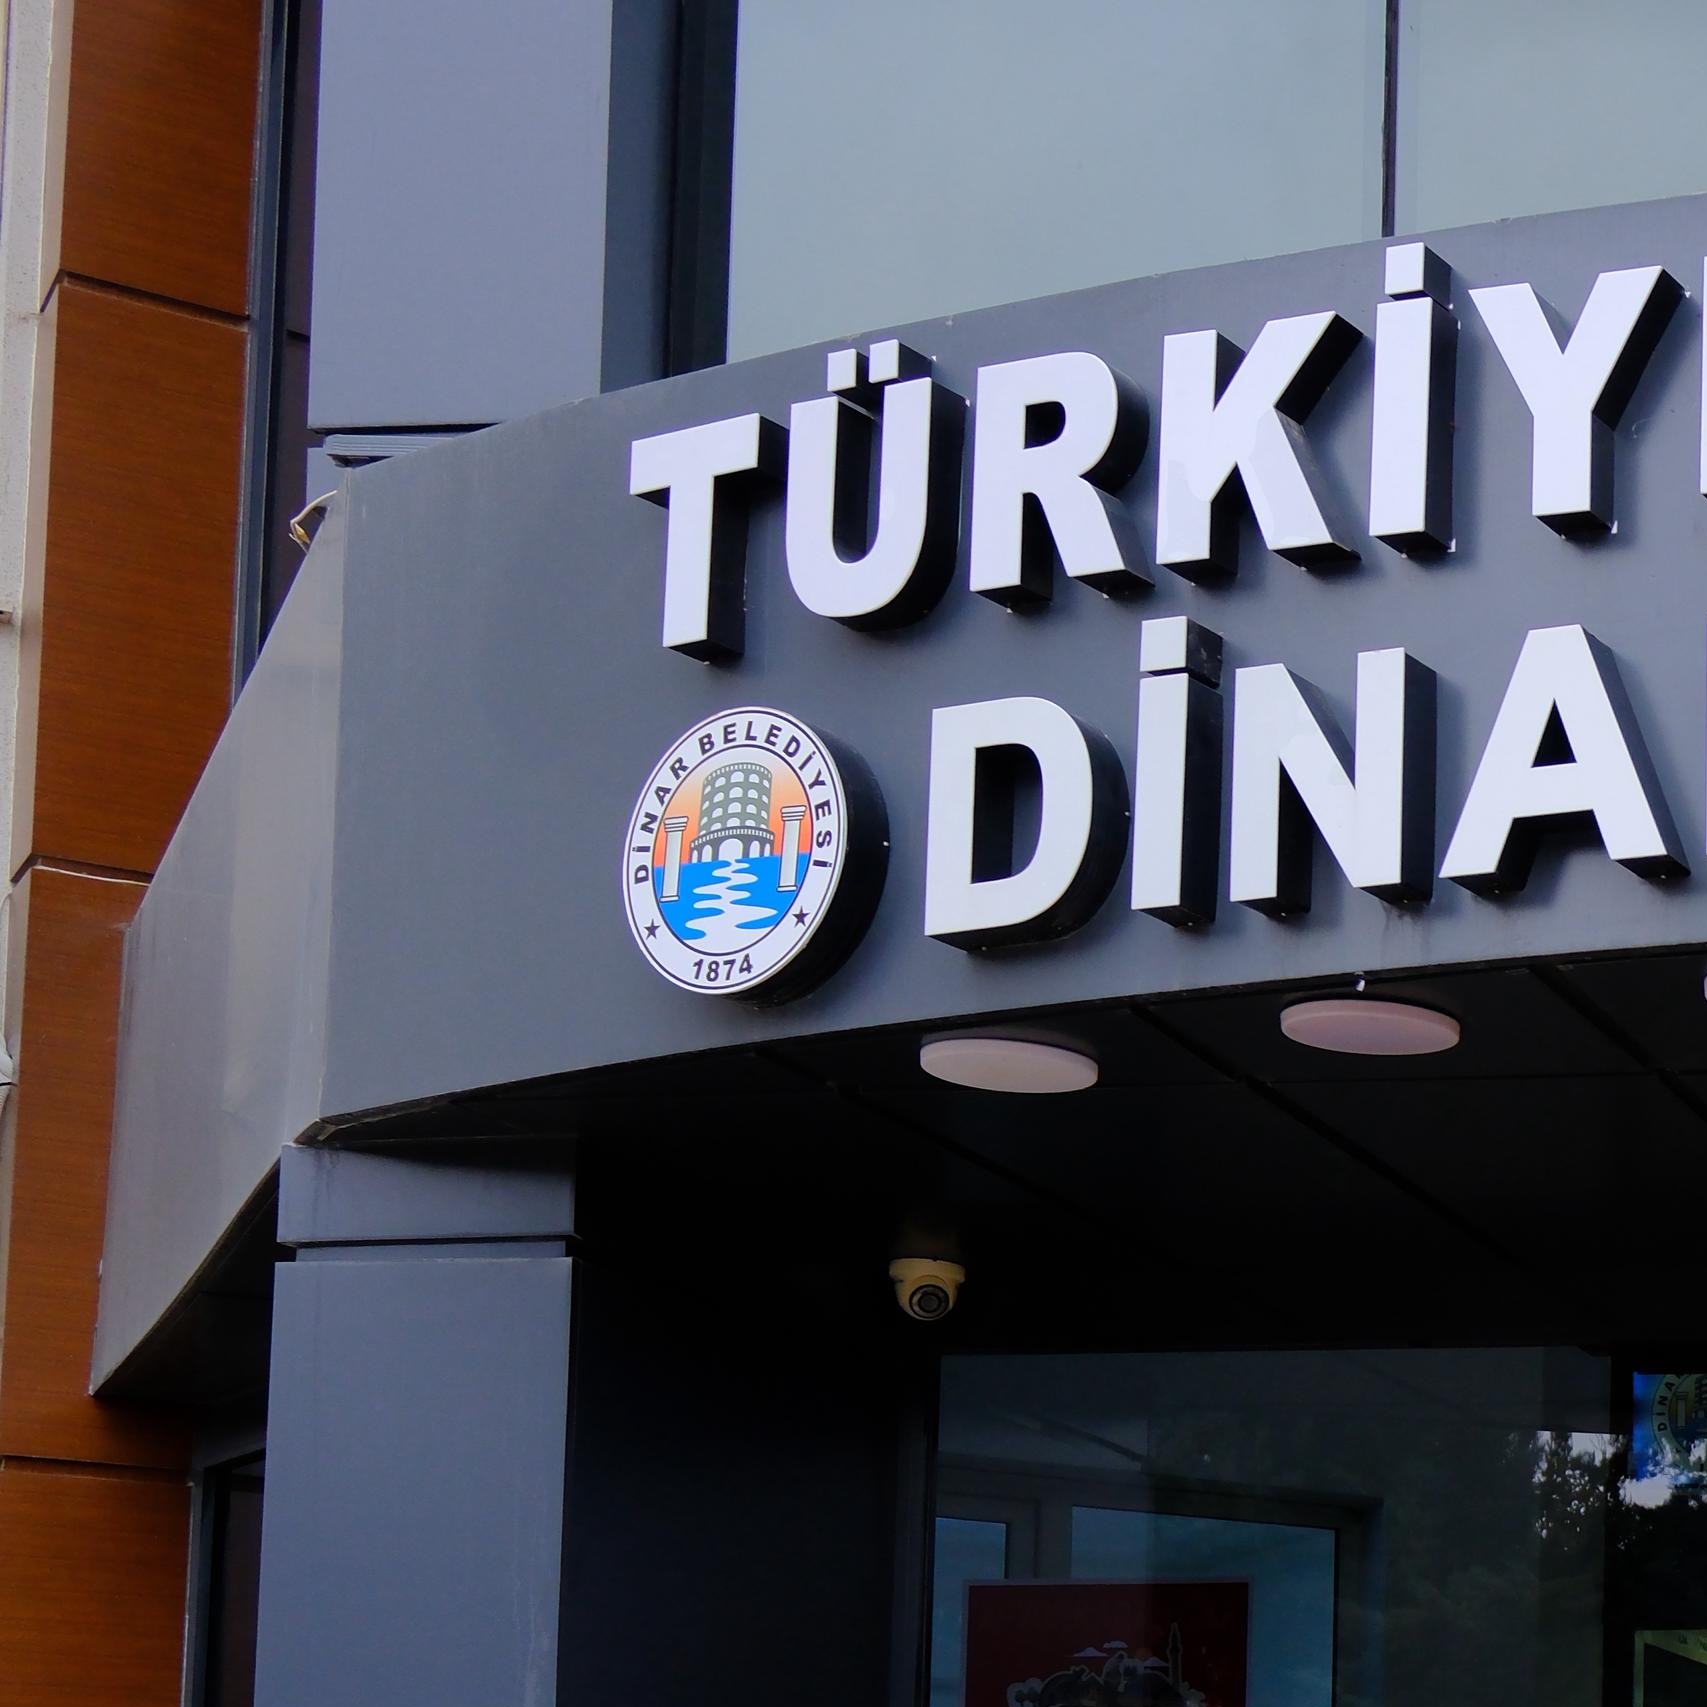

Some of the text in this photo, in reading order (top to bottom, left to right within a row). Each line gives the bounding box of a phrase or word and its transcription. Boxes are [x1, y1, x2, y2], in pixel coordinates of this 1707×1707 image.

[632, 720, 833, 885] DİNAR BELEDİYESİ
[692, 952, 754, 983] 1874
